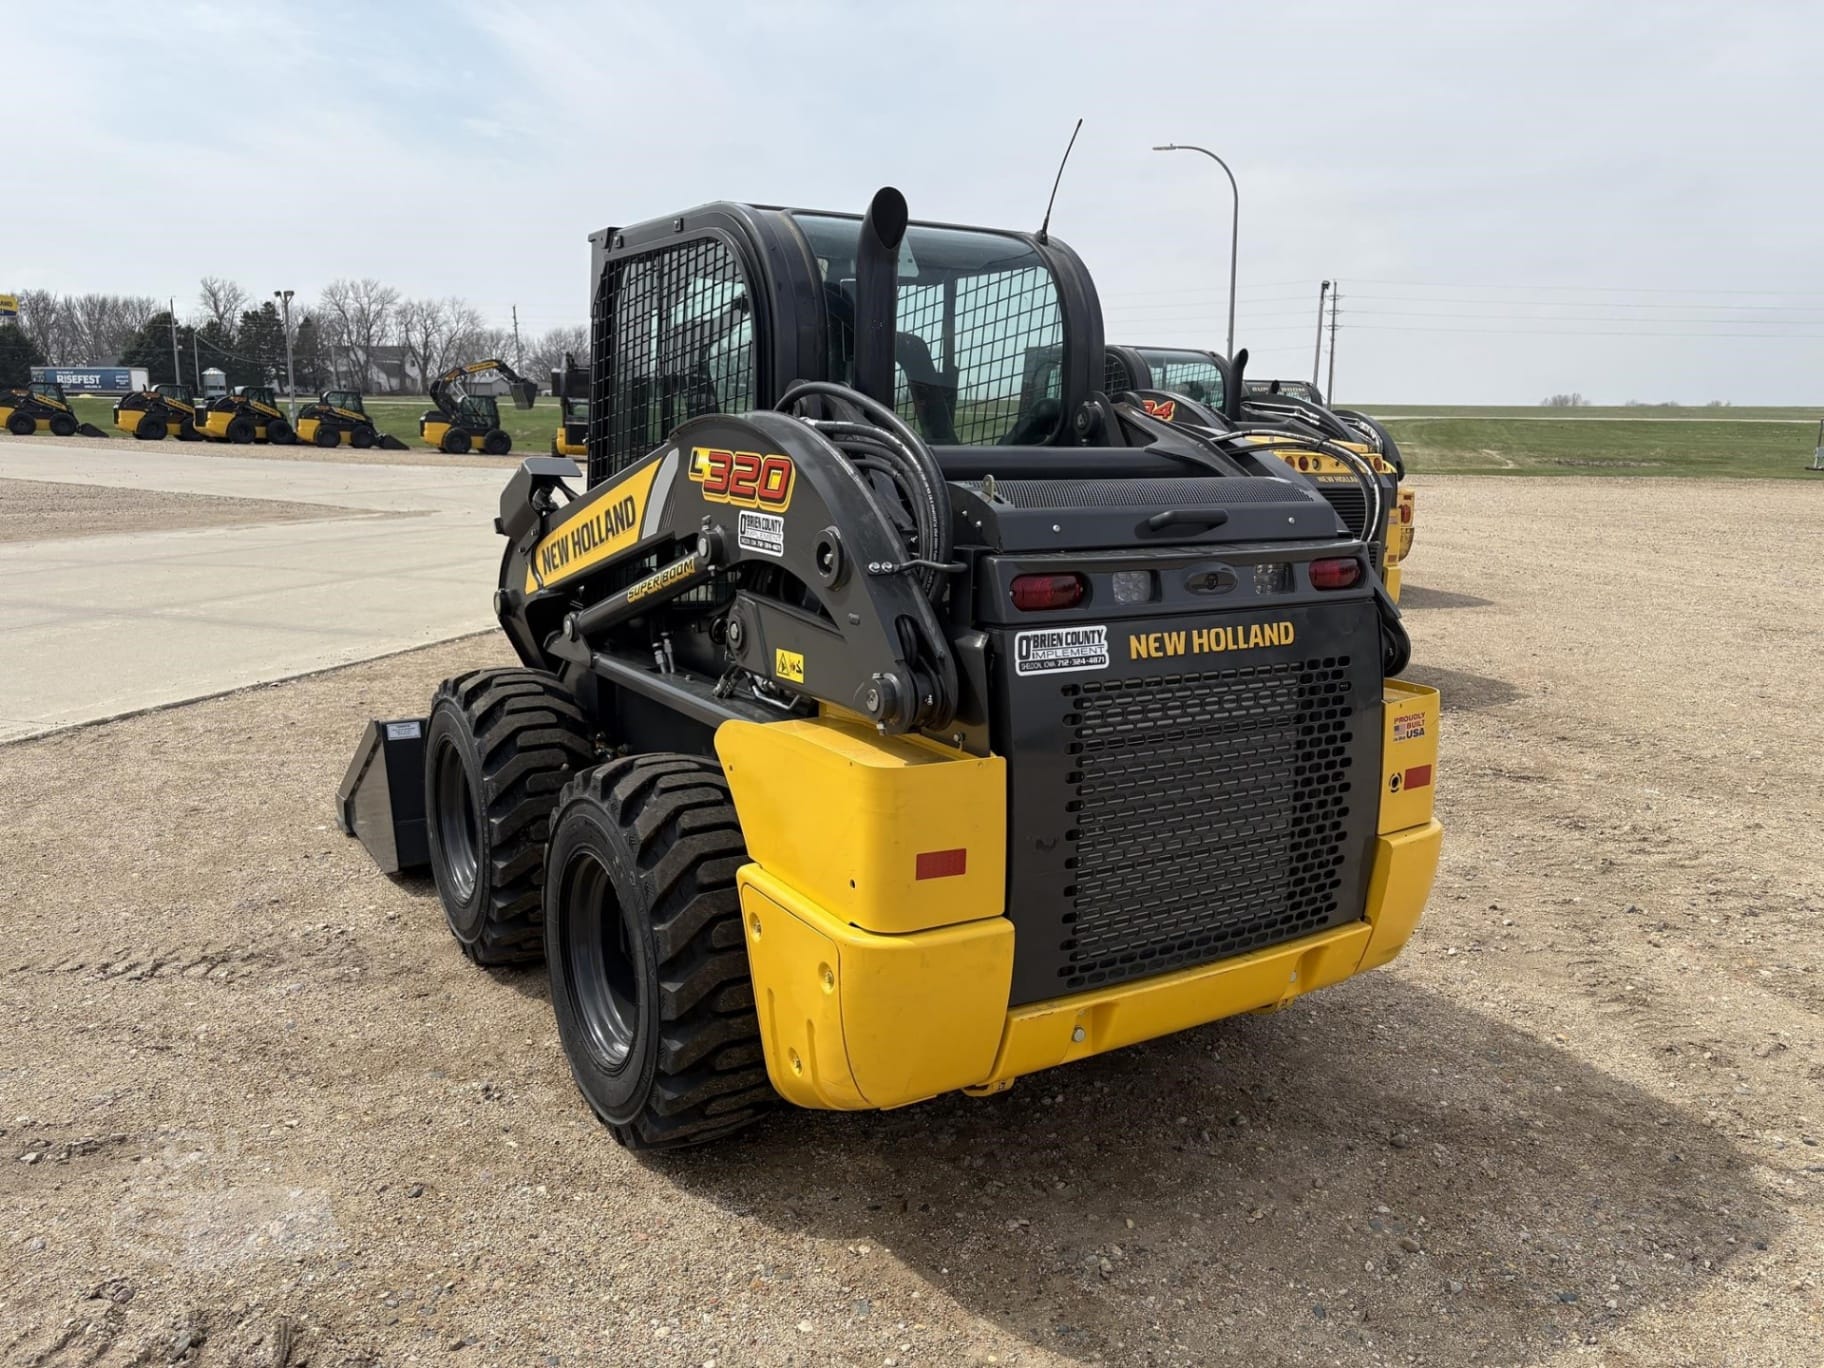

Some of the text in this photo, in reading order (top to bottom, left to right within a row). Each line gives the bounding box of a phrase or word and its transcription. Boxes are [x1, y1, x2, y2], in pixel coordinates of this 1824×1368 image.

[56, 374, 101, 385] RISEFEST
[689, 447, 796, 513] L320
[541, 494, 636, 576] NEW HOLLAND
[628, 558, 694, 600] SUPER BOOM
[1018, 629, 1104, 660] O'BRIEN COUNTY
[1031, 646, 1104, 660] IMPLEMENT
[1129, 621, 1295, 660] NEW HOLLAND
[1394, 711, 1425, 724] PROUDLY
[1406, 728, 1425, 739] USA
